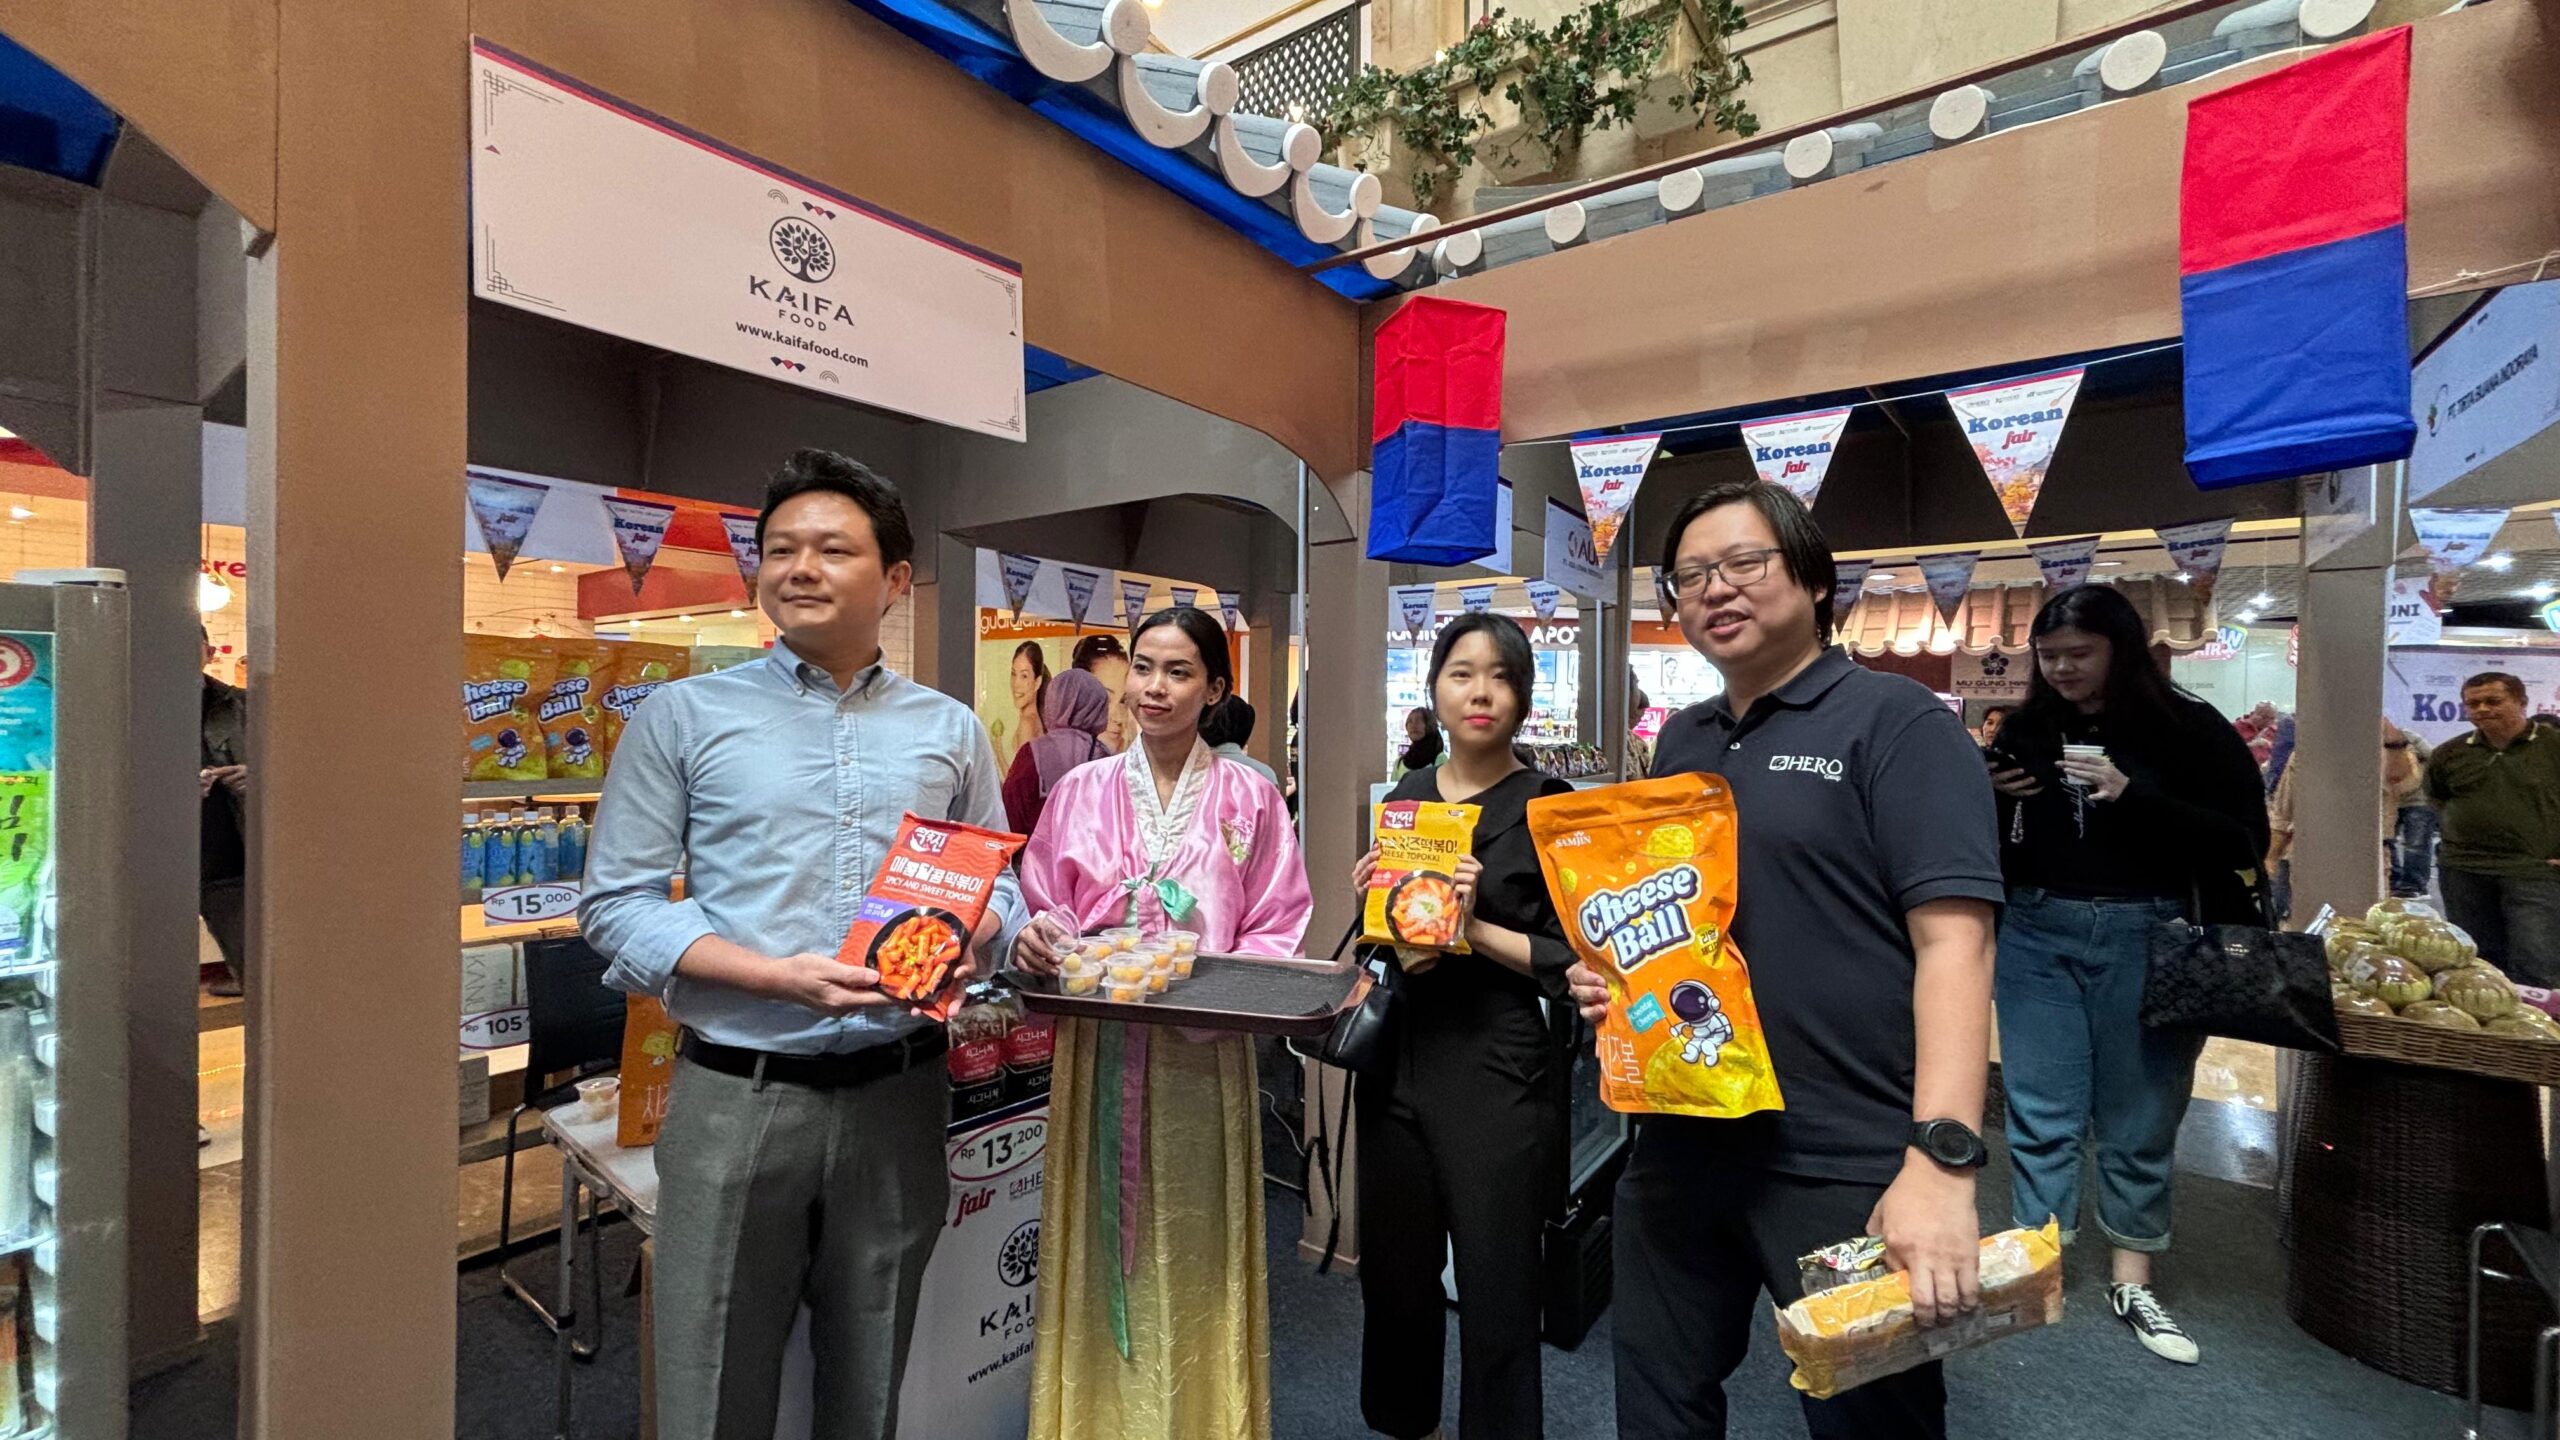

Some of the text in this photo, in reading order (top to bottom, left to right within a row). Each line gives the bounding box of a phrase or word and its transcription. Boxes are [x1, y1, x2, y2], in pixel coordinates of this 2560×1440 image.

[750, 275, 854, 326] KAIFA
[778, 309, 827, 331] FOOD
[736, 322, 869, 368] www.kaifafood.com
[1967, 408, 2064, 434] Korean
[2002, 429, 2037, 450] fair
[1756, 442, 1831, 462] Korean
[1580, 463, 1643, 478] Korean
[1781, 460, 1811, 478] fair
[1600, 479, 1624, 494] fair
[614, 518, 664, 533] Korean
[631, 532, 651, 543] fair
[2168, 536, 2225, 550] Korean
[2040, 556, 2092, 569] Korean
[2191, 549, 2210, 560] fair
[471, 694, 513, 720] Ball
[541, 695, 581, 721] Ball
[1788, 755, 1843, 775] HERO
[1555, 833, 1592, 848] SAMJIN
[1381, 849, 1404, 859] HEESE
[904, 879, 920, 891] AND
[920, 882, 944, 897] SWEET
[1582, 868, 1694, 944] Cheese
[1611, 903, 1686, 966] Ball
[953, 1187, 996, 1228] fair
[980, 1294, 1031, 1337] KAI
[1004, 1316, 1035, 1340] FOO
